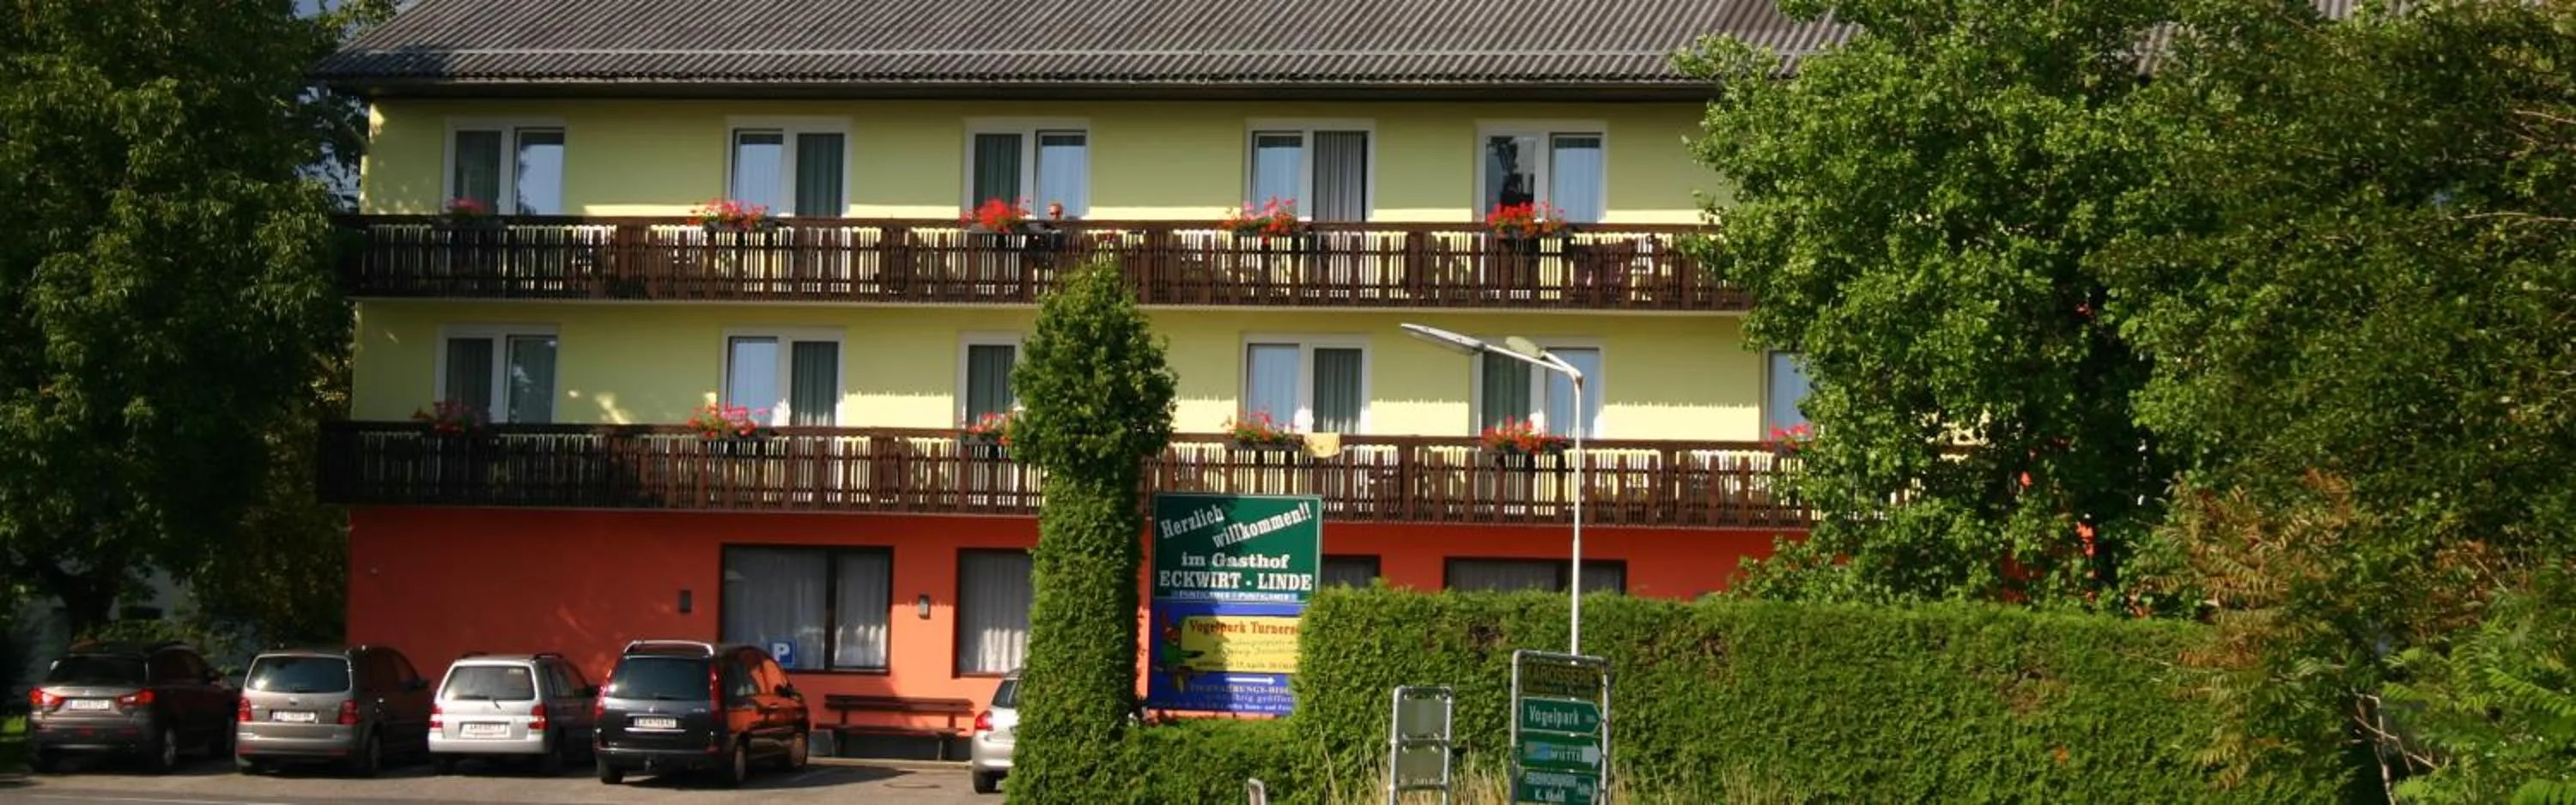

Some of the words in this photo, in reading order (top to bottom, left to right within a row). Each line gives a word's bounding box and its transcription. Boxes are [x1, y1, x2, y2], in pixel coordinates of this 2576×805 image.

[1160, 504, 1225, 539] Herzlich
[1212, 501, 1312, 548] willkommen!!
[1181, 552, 1206, 566] im
[1212, 553, 1291, 569] Gasthof
[1257, 573, 1313, 591] LINDE
[1189, 620, 1246, 636] Vogelpark
[773, 643, 791, 662] P
[1529, 705, 1580, 729] Vogelpark
